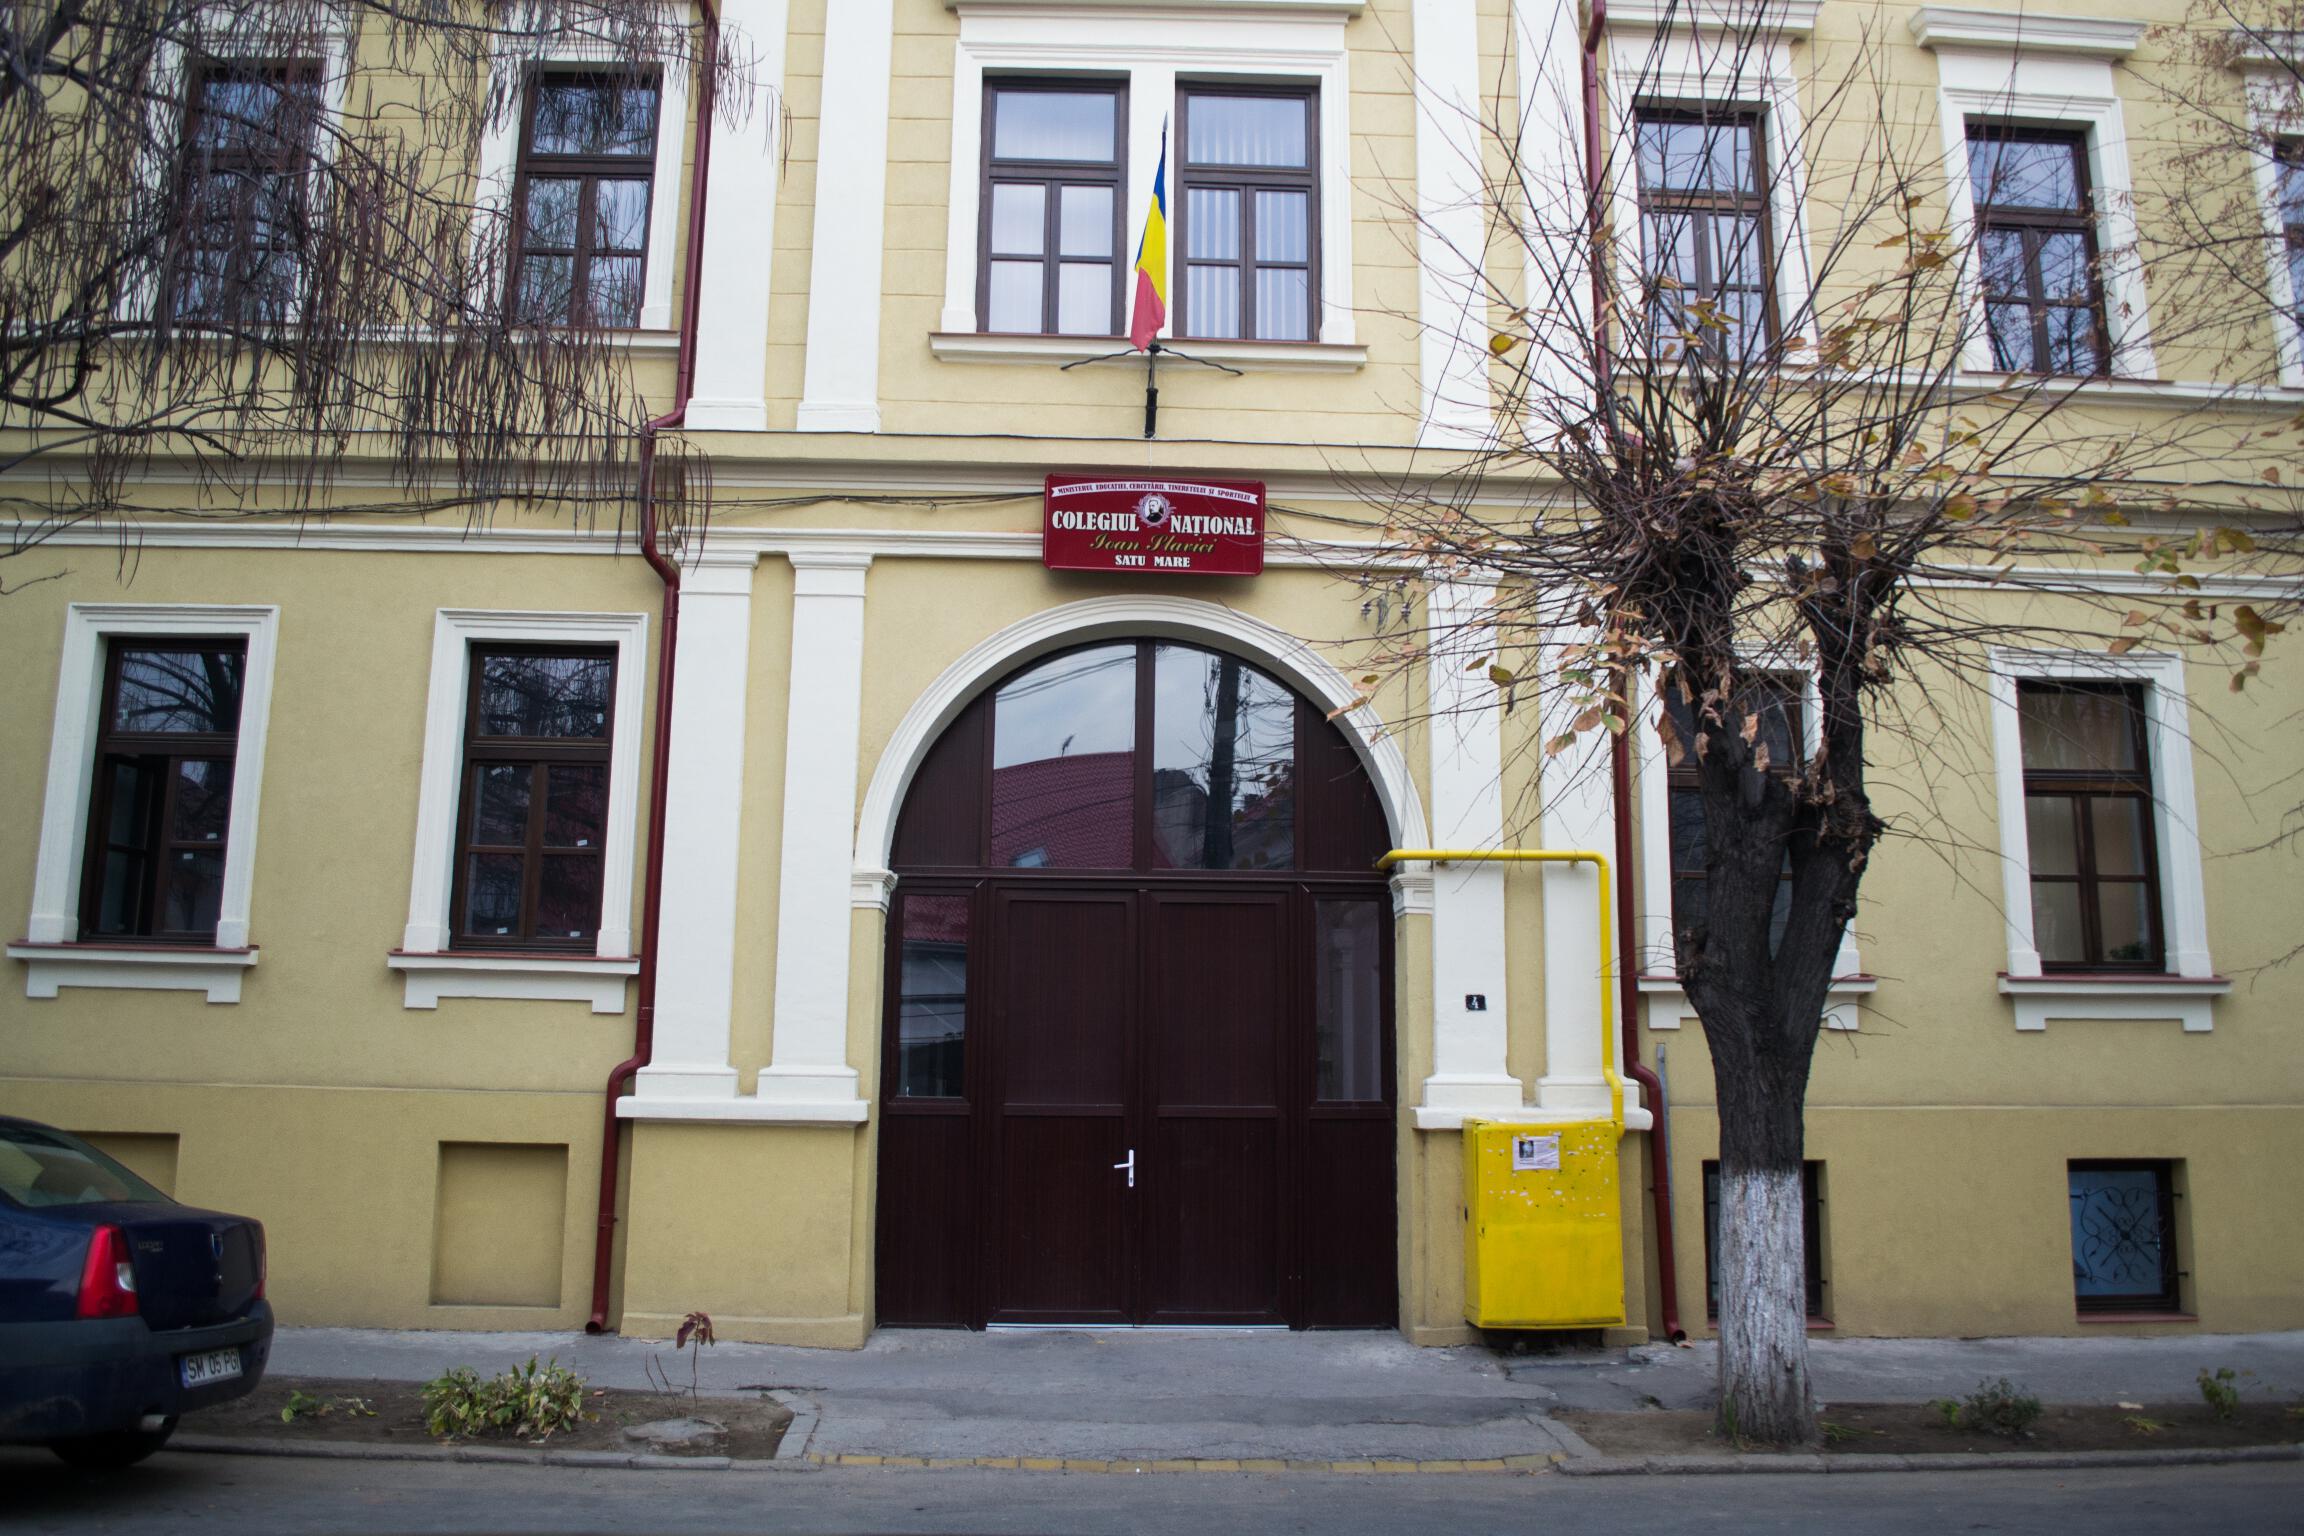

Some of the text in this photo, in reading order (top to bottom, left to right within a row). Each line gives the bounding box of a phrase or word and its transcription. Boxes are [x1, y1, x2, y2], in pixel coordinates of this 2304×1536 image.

[1057, 484, 1093, 494] MINISTERUL
[1217, 489, 1251, 501] SPORTULUI
[1052, 511, 1255, 536] COLEGIUL NAȚIONAL
[1089, 534, 1218, 553] Ioan Slavici
[1115, 554, 1191, 568] SATU MARE
[1471, 996, 1479, 1009] 4
[187, 1357, 205, 1380] SM
[209, 1354, 222, 1375] 05
